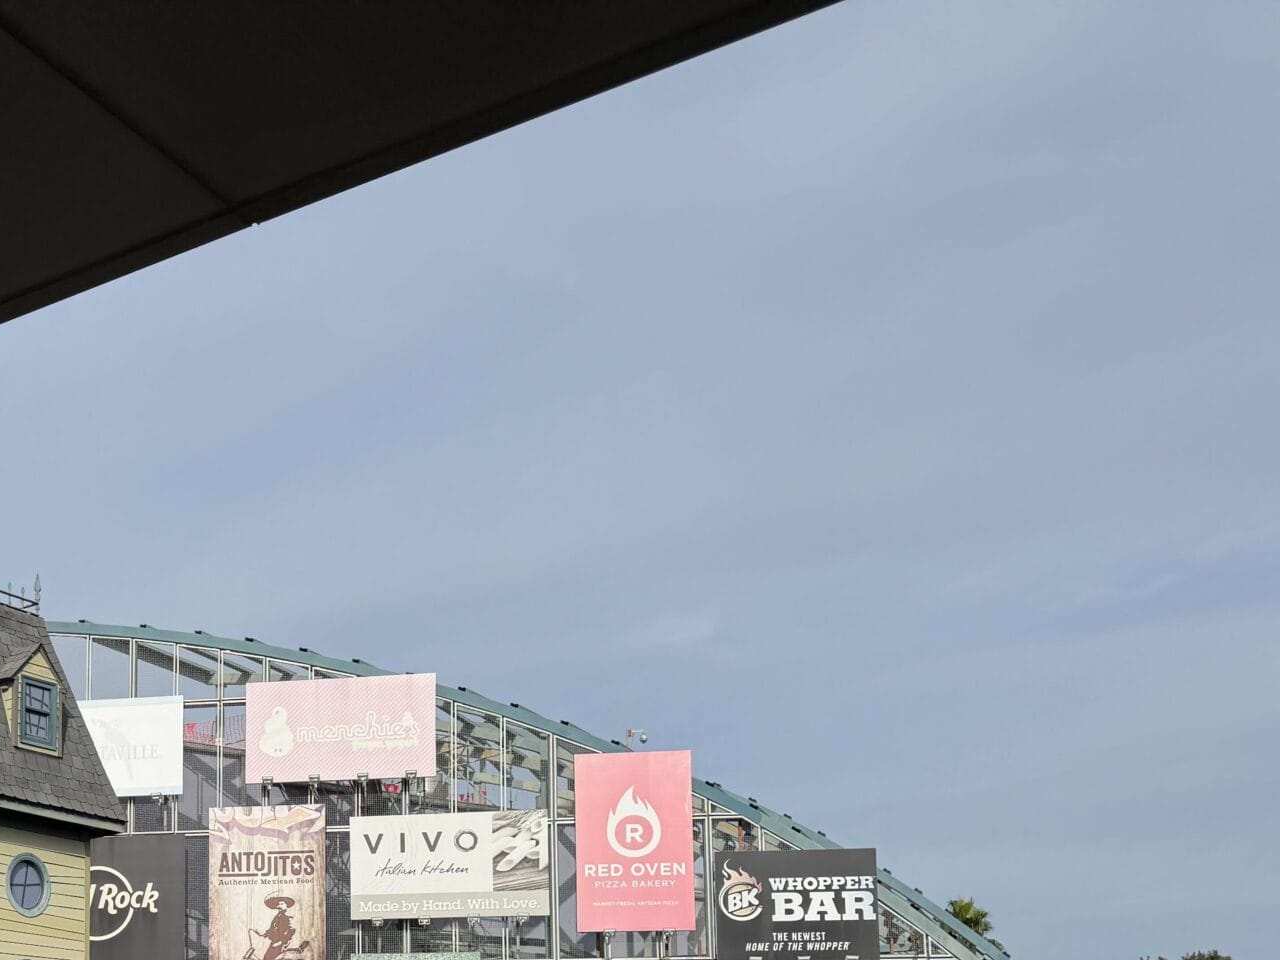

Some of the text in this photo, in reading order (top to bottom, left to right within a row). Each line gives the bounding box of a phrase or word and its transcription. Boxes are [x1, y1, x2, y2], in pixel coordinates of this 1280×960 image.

[625, 823, 645, 843] R
[363, 830, 478, 854] VIVO
[218, 851, 315, 877] ANTOJITOS
[584, 862, 686, 877] RED OVEN
[260, 878, 294, 886] Mexican
[594, 879, 676, 888] PIZZA BAKERY
[768, 876, 875, 891] WHOPPER
[98, 882, 160, 915] Rock
[359, 898, 541, 914] Made by Hand. With Love.
[727, 887, 760, 913] BK
[771, 890, 877, 922] BAR
[772, 931, 826, 941] THE NEWEST
[745, 941, 851, 952] HOME OF THE WHOPPER
